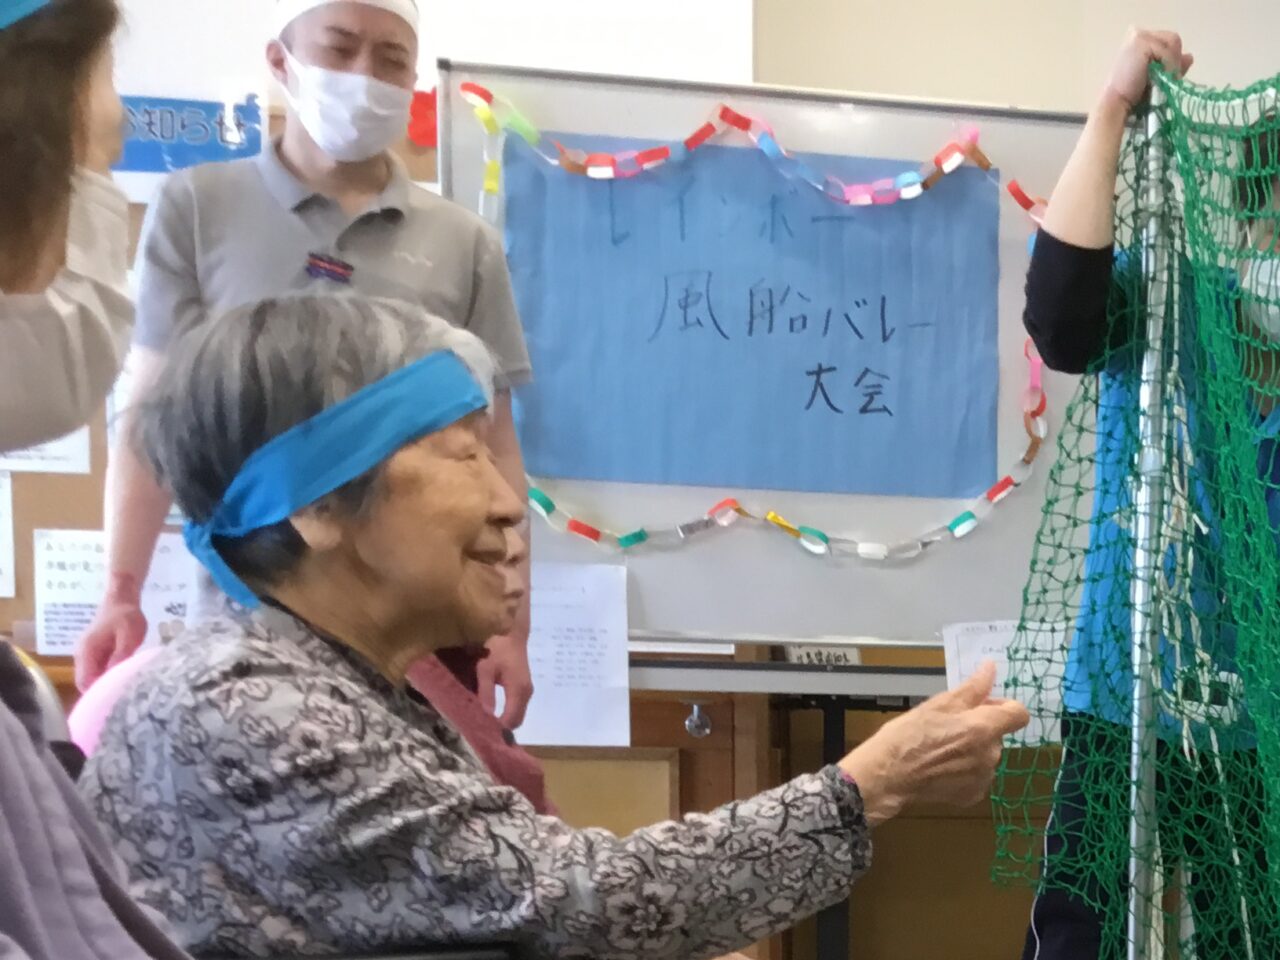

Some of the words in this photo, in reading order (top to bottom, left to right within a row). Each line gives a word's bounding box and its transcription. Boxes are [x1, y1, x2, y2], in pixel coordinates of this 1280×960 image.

[648, 269, 936, 344] 風船バレー
[804, 362, 894, 417] 大会
